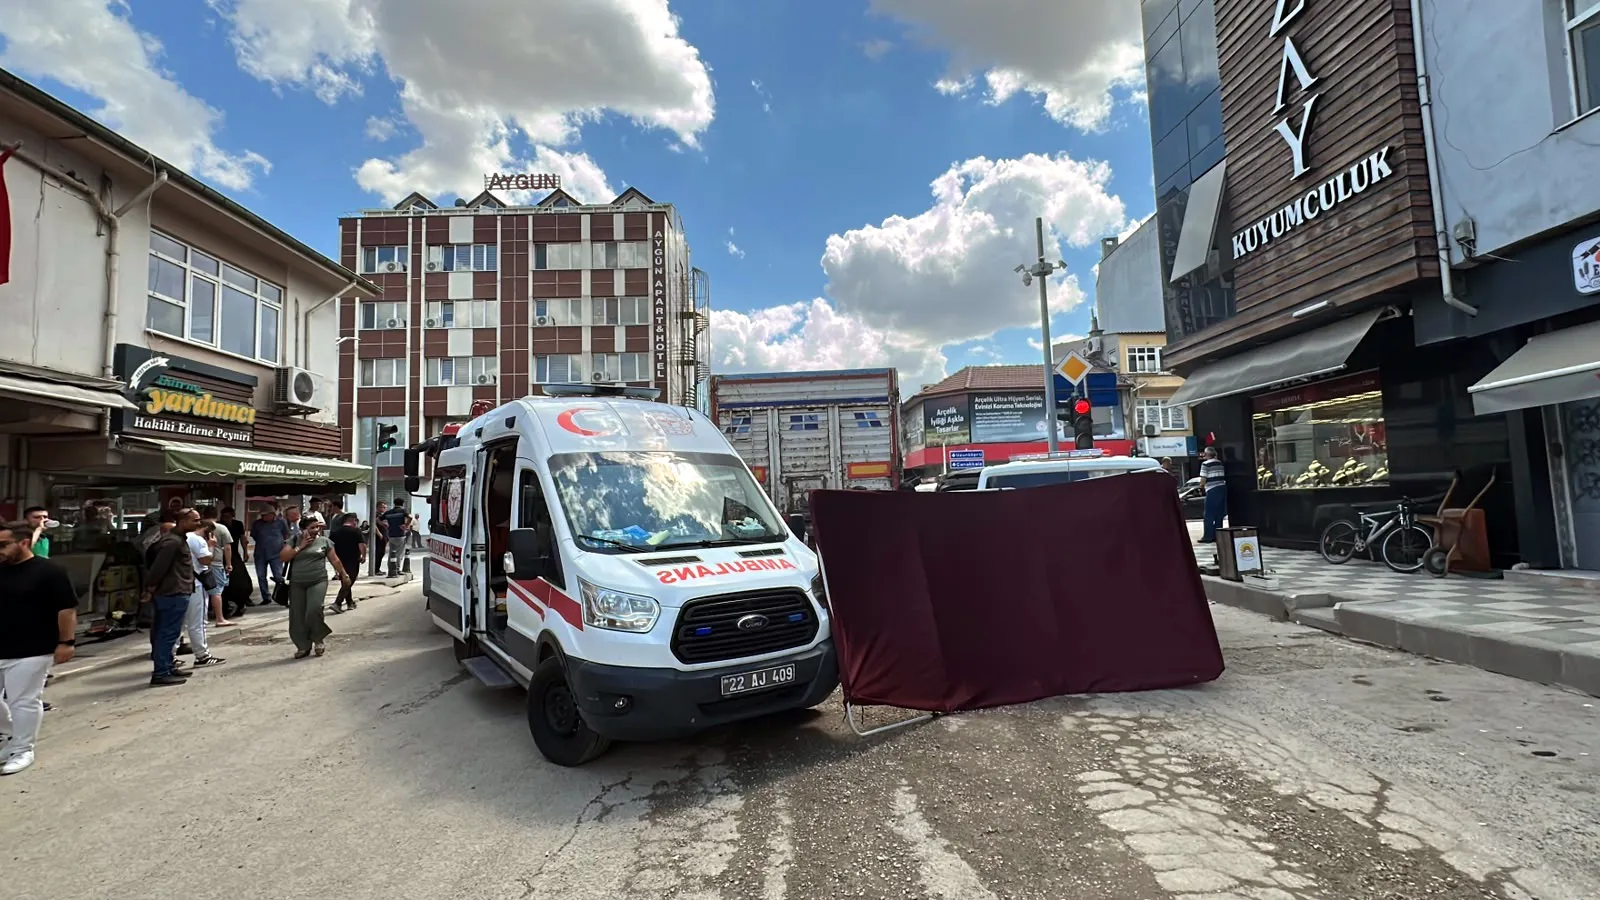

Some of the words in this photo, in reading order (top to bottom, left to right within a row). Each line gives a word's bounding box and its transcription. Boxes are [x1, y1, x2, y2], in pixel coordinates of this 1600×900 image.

[1231, 146, 1393, 260] KUYUMCULUK
[654, 230, 663, 275] AYGÜN
[654, 280, 665, 378] APART&HOTEL
[936, 406, 957, 416] Arçelik
[133, 416, 175, 432] Hakiki
[177, 422, 214, 437] Edirne
[215, 428, 251, 442] Peyniri
[729, 675, 745, 692] 22
[751, 672, 766, 688] AJ
[772, 666, 793, 683] 409
